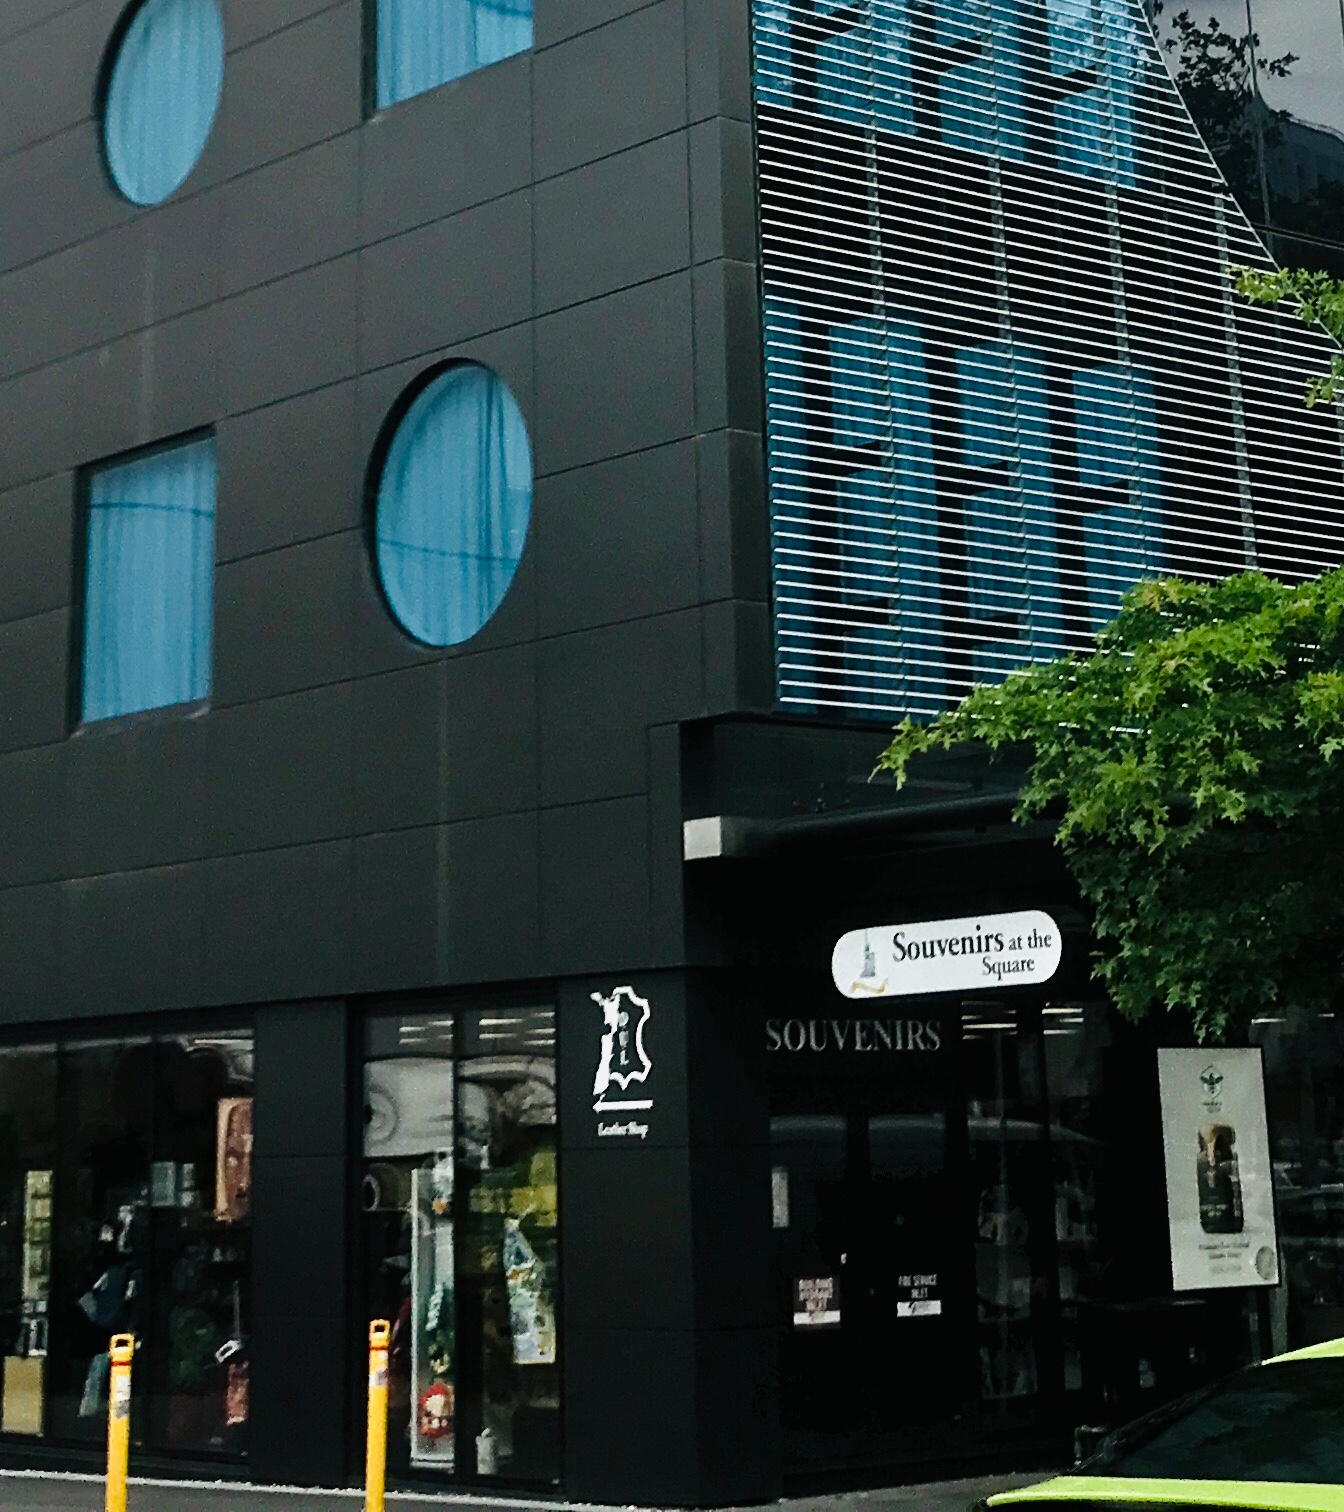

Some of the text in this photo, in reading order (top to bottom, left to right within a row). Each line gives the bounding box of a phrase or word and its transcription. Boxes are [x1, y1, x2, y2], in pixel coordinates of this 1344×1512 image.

[892, 924, 1052, 963] Souvenirs at the
[982, 955, 1035, 980] Square
[765, 1018, 942, 1052] SOUVENIRS
